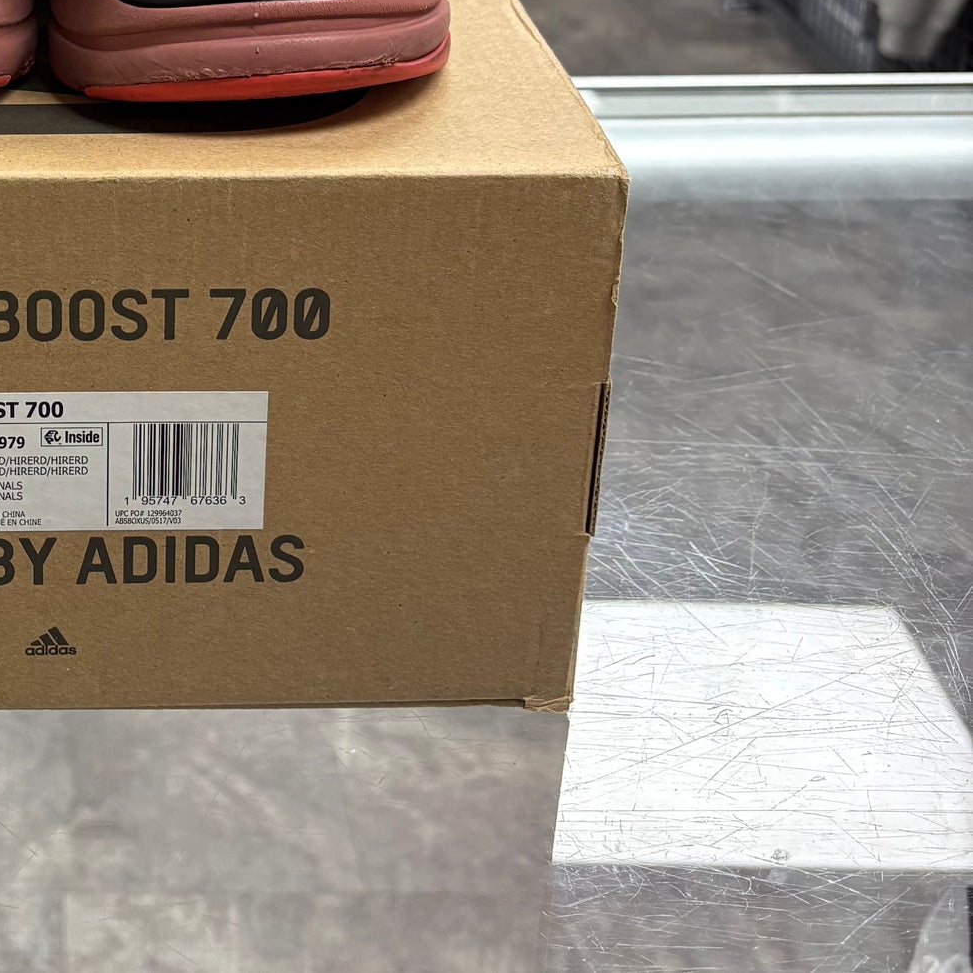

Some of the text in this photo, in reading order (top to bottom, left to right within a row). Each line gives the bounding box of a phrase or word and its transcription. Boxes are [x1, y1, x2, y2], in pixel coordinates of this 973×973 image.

[209, 287, 331, 341] 700
[25, 401, 64, 419] 700
[64, 430, 101, 444] Inside
[141, 496, 177, 506] 95747
[190, 495, 227, 505] 67636
[238, 496, 246, 505] 3
[19, 518, 42, 526] CHINE
[76, 535, 305, 585] ADIDAS
[25, 644, 77, 656] adidas
